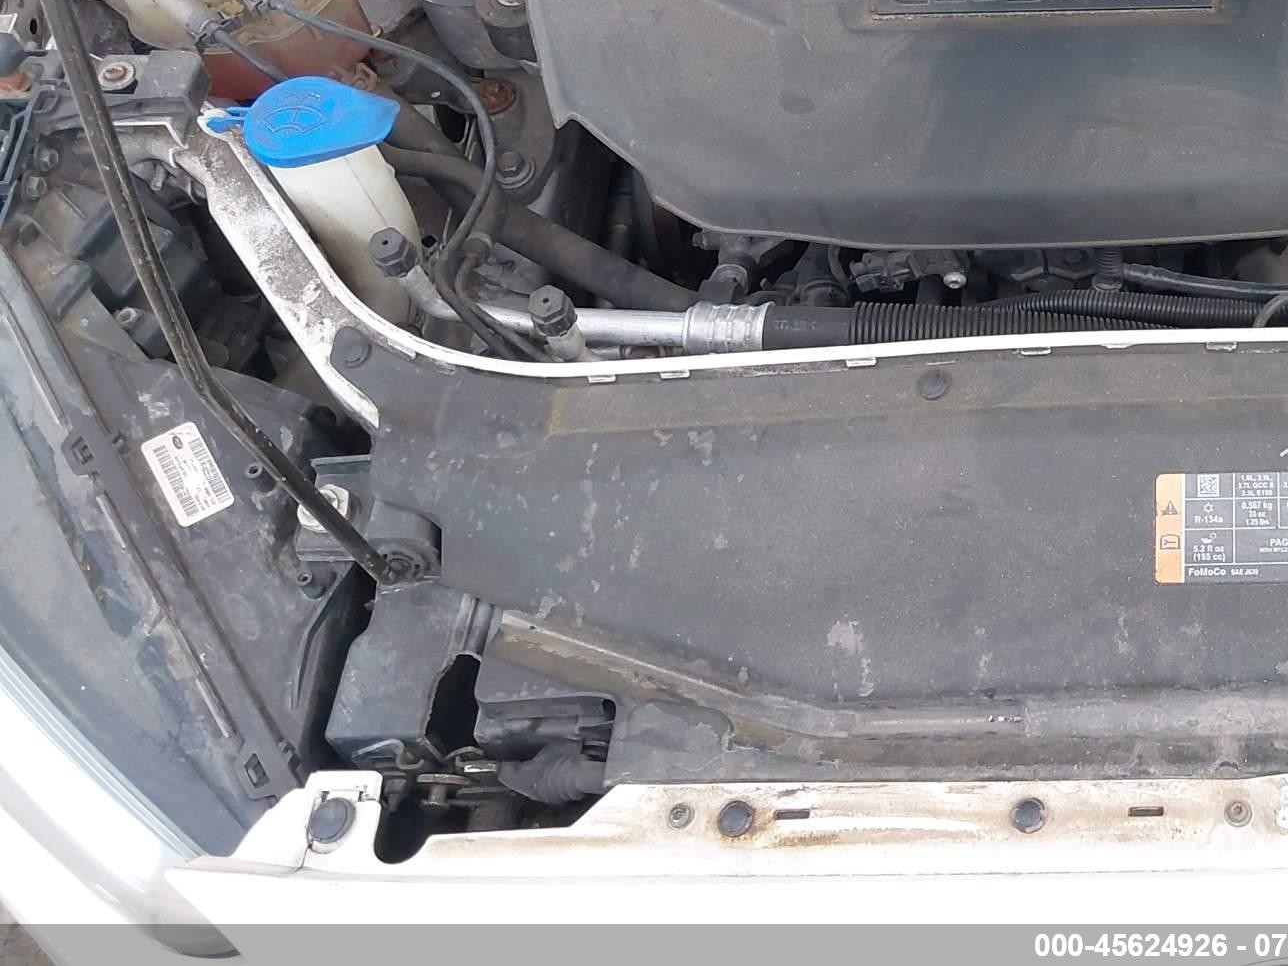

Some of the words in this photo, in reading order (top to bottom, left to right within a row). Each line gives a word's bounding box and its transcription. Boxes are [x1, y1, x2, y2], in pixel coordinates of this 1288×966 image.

[1263, 500, 1273, 511] kg
[1194, 515, 1224, 524] R-134a
[1269, 538, 1288, 547] PAG
[1193, 545, 1206, 553] 5.2
[1207, 545, 1213, 553] fl
[1193, 553, 1211, 562] (155
[1212, 553, 1226, 562] cc)
[1188, 567, 1227, 576] FoMoCo
[1230, 568, 1244, 576] SAE
